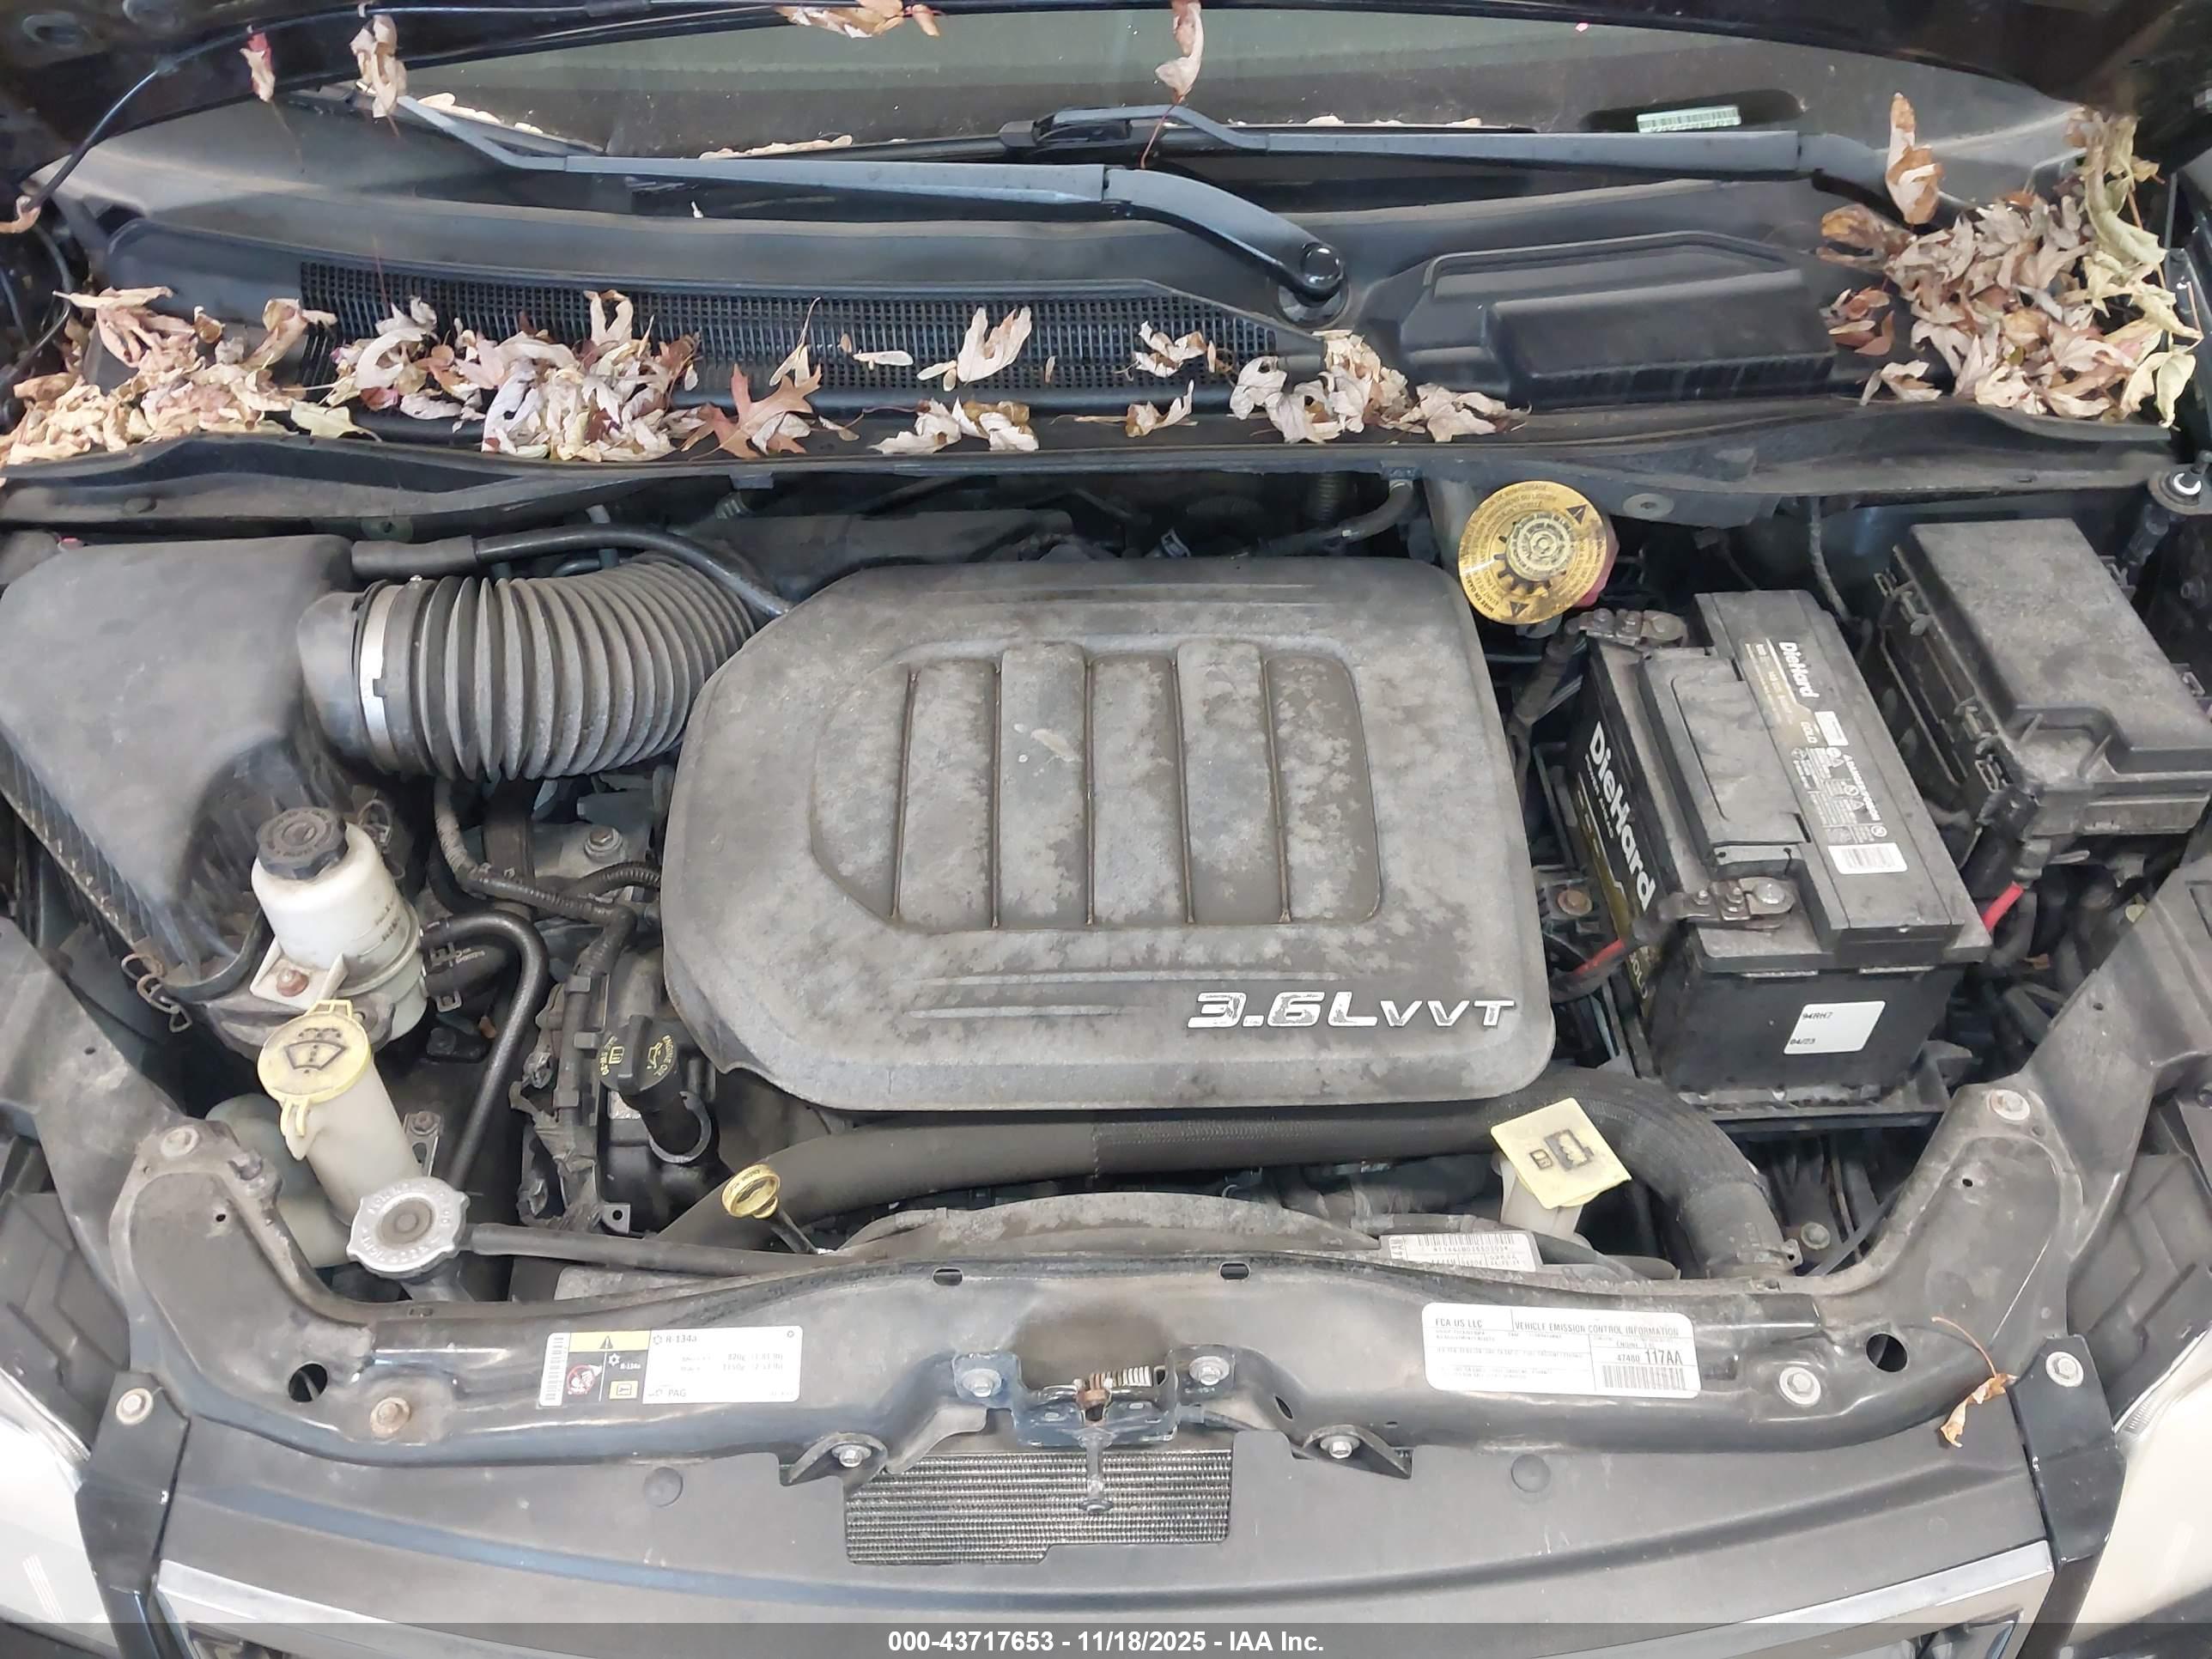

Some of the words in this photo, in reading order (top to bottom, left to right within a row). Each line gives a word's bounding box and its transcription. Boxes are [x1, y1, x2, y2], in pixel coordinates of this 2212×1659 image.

[1779, 641, 1820, 698] DieHard
[1589, 720, 1656, 913] DieHard
[1379, 1000, 1516, 1027] VVT
[662, 1035, 674, 1064] ENGINE
[1435, 1318, 1451, 1327] FCA
[1454, 1319, 1465, 1328] US
[1468, 1319, 1483, 1329] LLC
[1515, 1321, 1547, 1332] VEHICLE
[1549, 1322, 1586, 1334] EMISSION
[1588, 1324, 1623, 1334] CONTROL
[1626, 1325, 1680, 1337] INFORMATION
[667, 1388, 687, 1397] PAG
